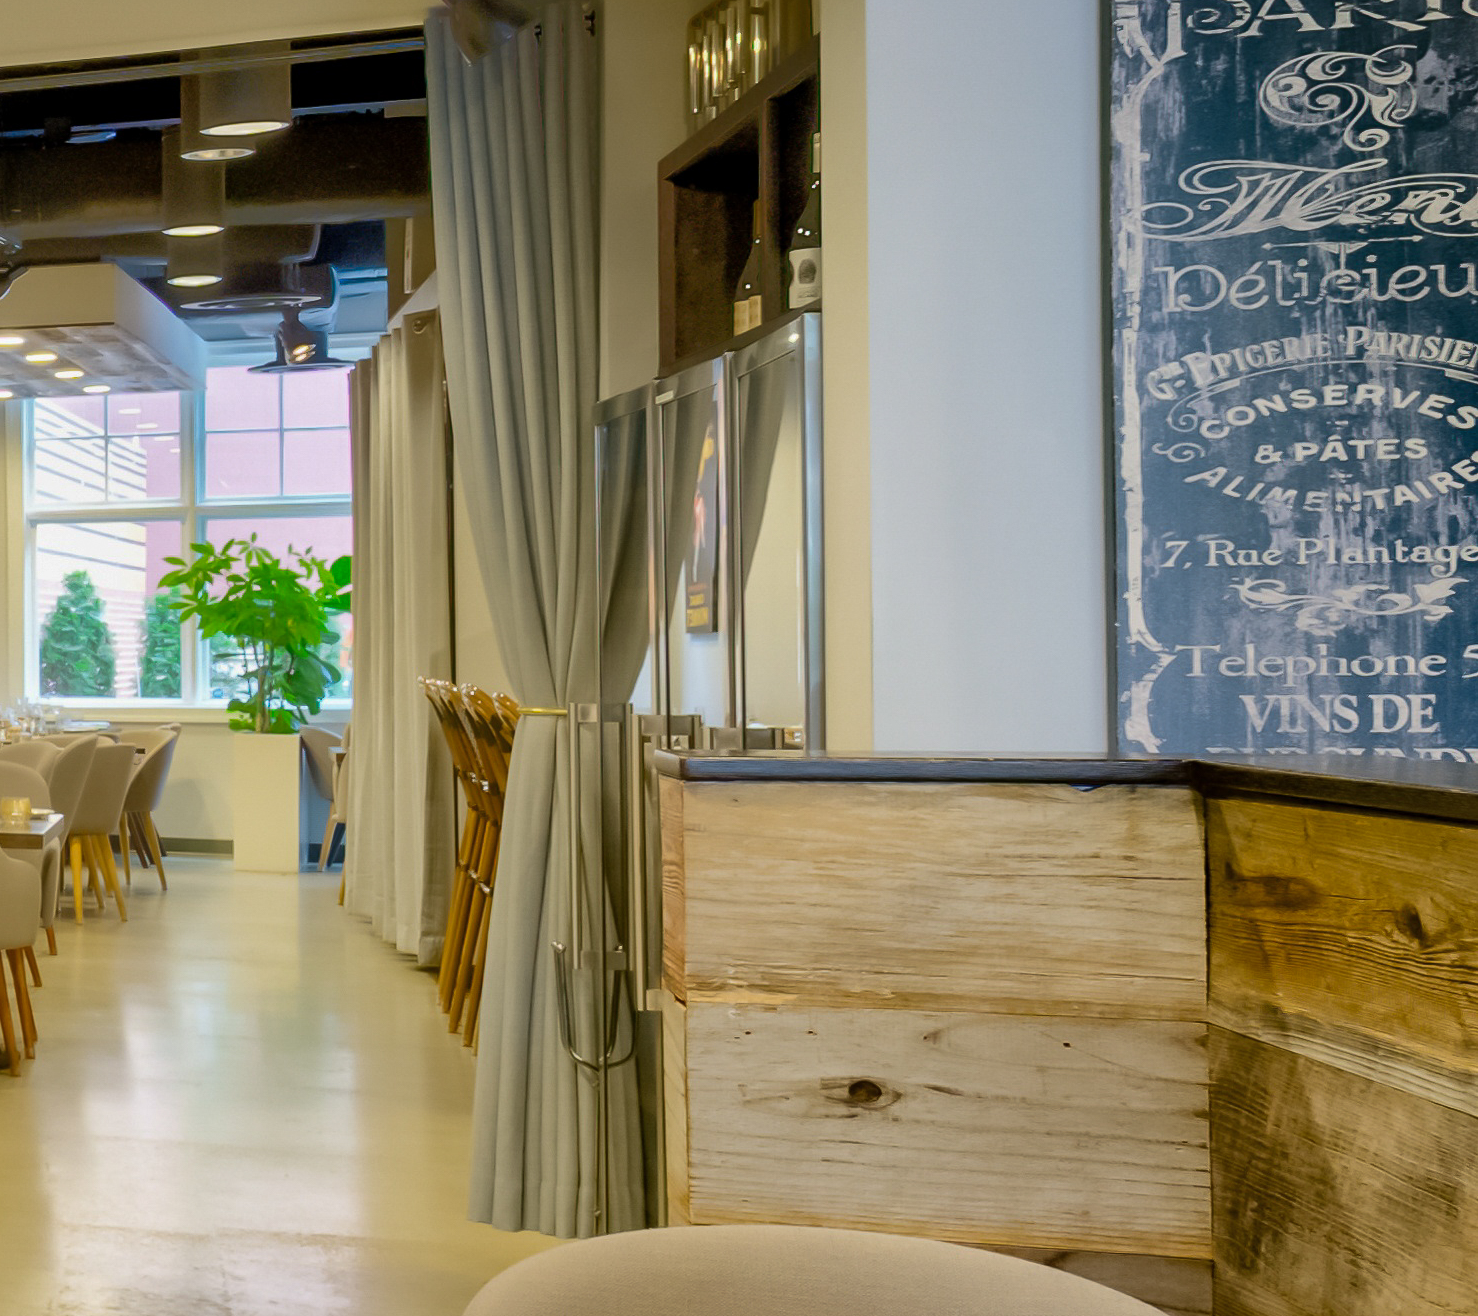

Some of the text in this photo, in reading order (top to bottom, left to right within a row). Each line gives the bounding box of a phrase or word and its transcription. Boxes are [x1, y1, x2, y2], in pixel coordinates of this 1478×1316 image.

[1199, 383, 1478, 440] CONSERVES
[1254, 434, 1429, 465] & PÂTES
[1183, 451, 1478, 513] ALIMENTAIRE
[1160, 538, 1478, 578] 7, Rue Plantage
[1174, 644, 1448, 687] Telephone
[1238, 693, 1440, 734] VINS DE
